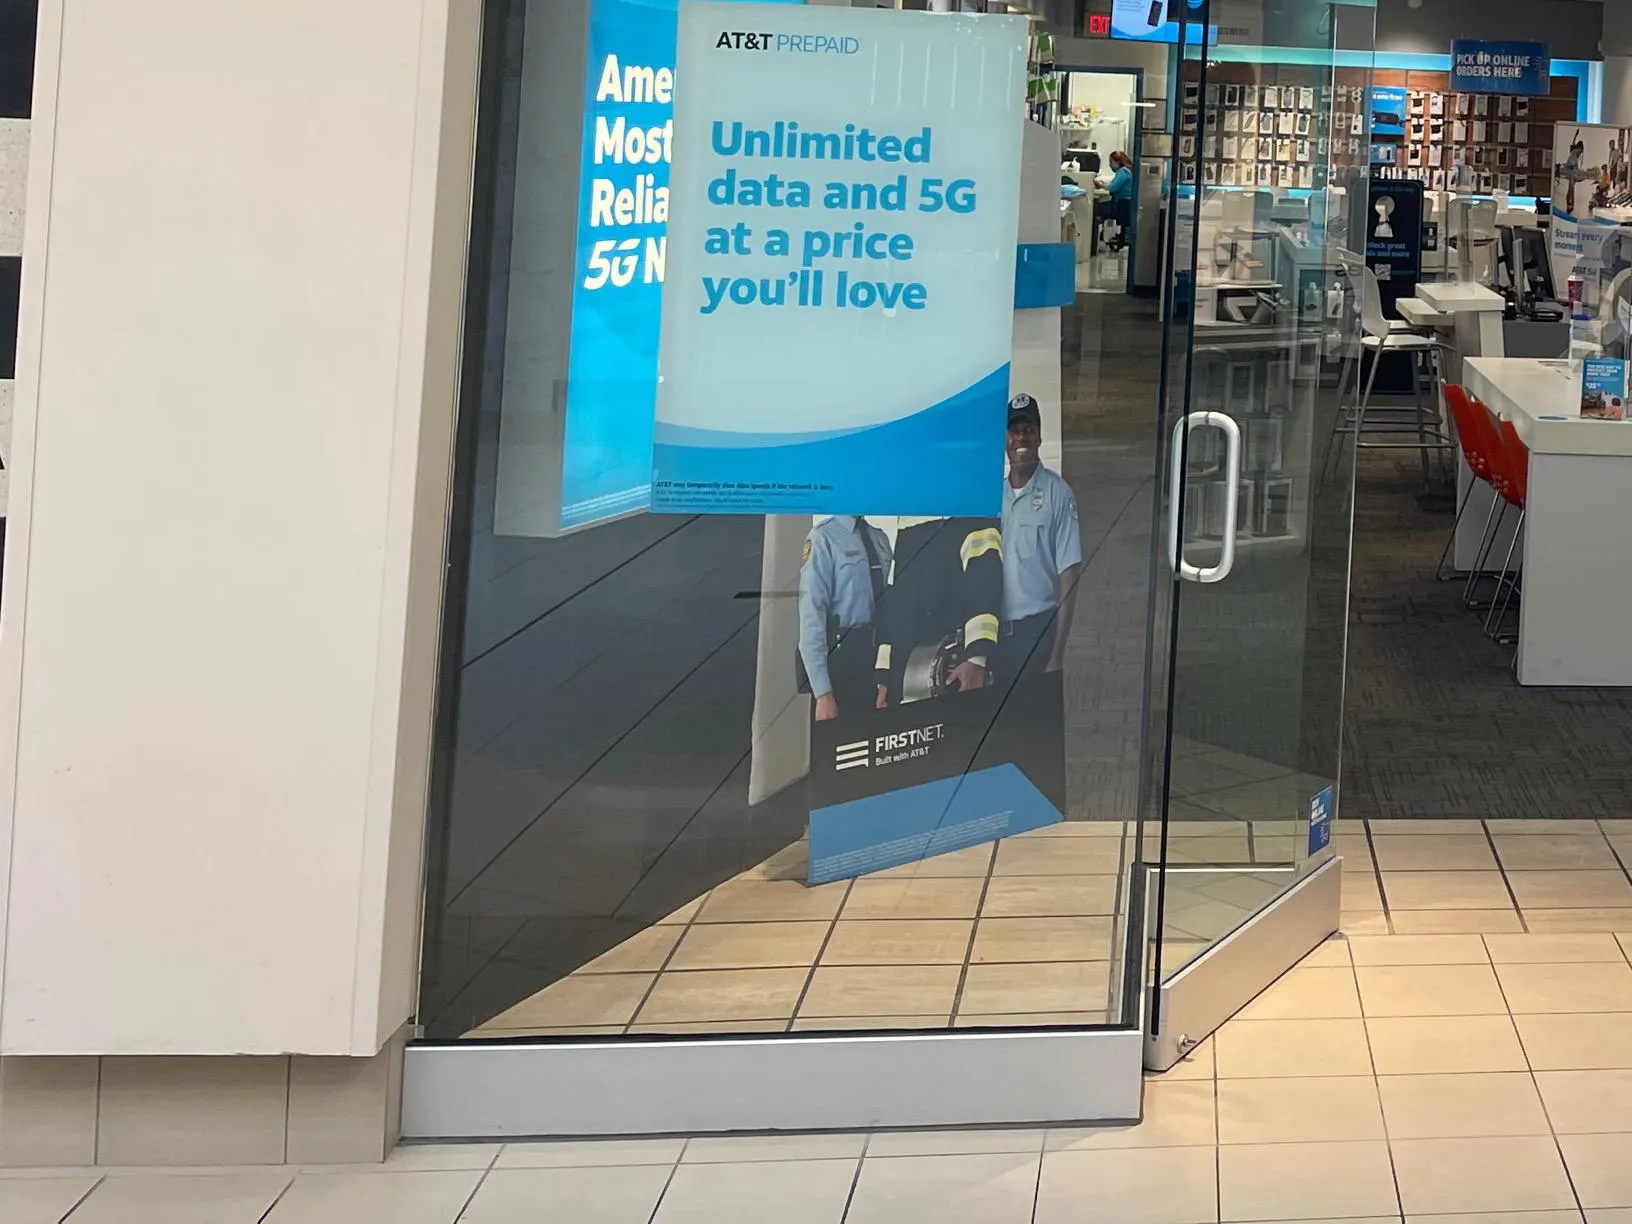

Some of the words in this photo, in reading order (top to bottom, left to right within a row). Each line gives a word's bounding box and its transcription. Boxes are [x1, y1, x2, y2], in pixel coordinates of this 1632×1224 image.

[716, 31, 773, 50] AT&T
[776, 34, 859, 54] PREPAID
[1456, 54, 1475, 65] PICK
[1477, 54, 1491, 65] UP
[1493, 55, 1530, 67] ONLINE
[596, 54, 676, 104] Ame
[1456, 66, 1491, 77] ORDERS
[1493, 67, 1522, 78] HERE
[594, 116, 673, 164] Most
[711, 120, 932, 164] Unlimited
[590, 173, 669, 227] Relia
[707, 168, 811, 208] data
[823, 175, 907, 211] and
[919, 178, 977, 214] 5G
[583, 238, 641, 290] 5G
[644, 236, 667, 283] N
[704, 222, 752, 256] at
[764, 229, 790, 257] a
[802, 222, 914, 267] price
[699, 270, 823, 314] you'll
[836, 271, 927, 310] love
[875, 757, 892, 766] Built
[893, 751, 909, 762] with
[910, 746, 930, 758] AT&T
